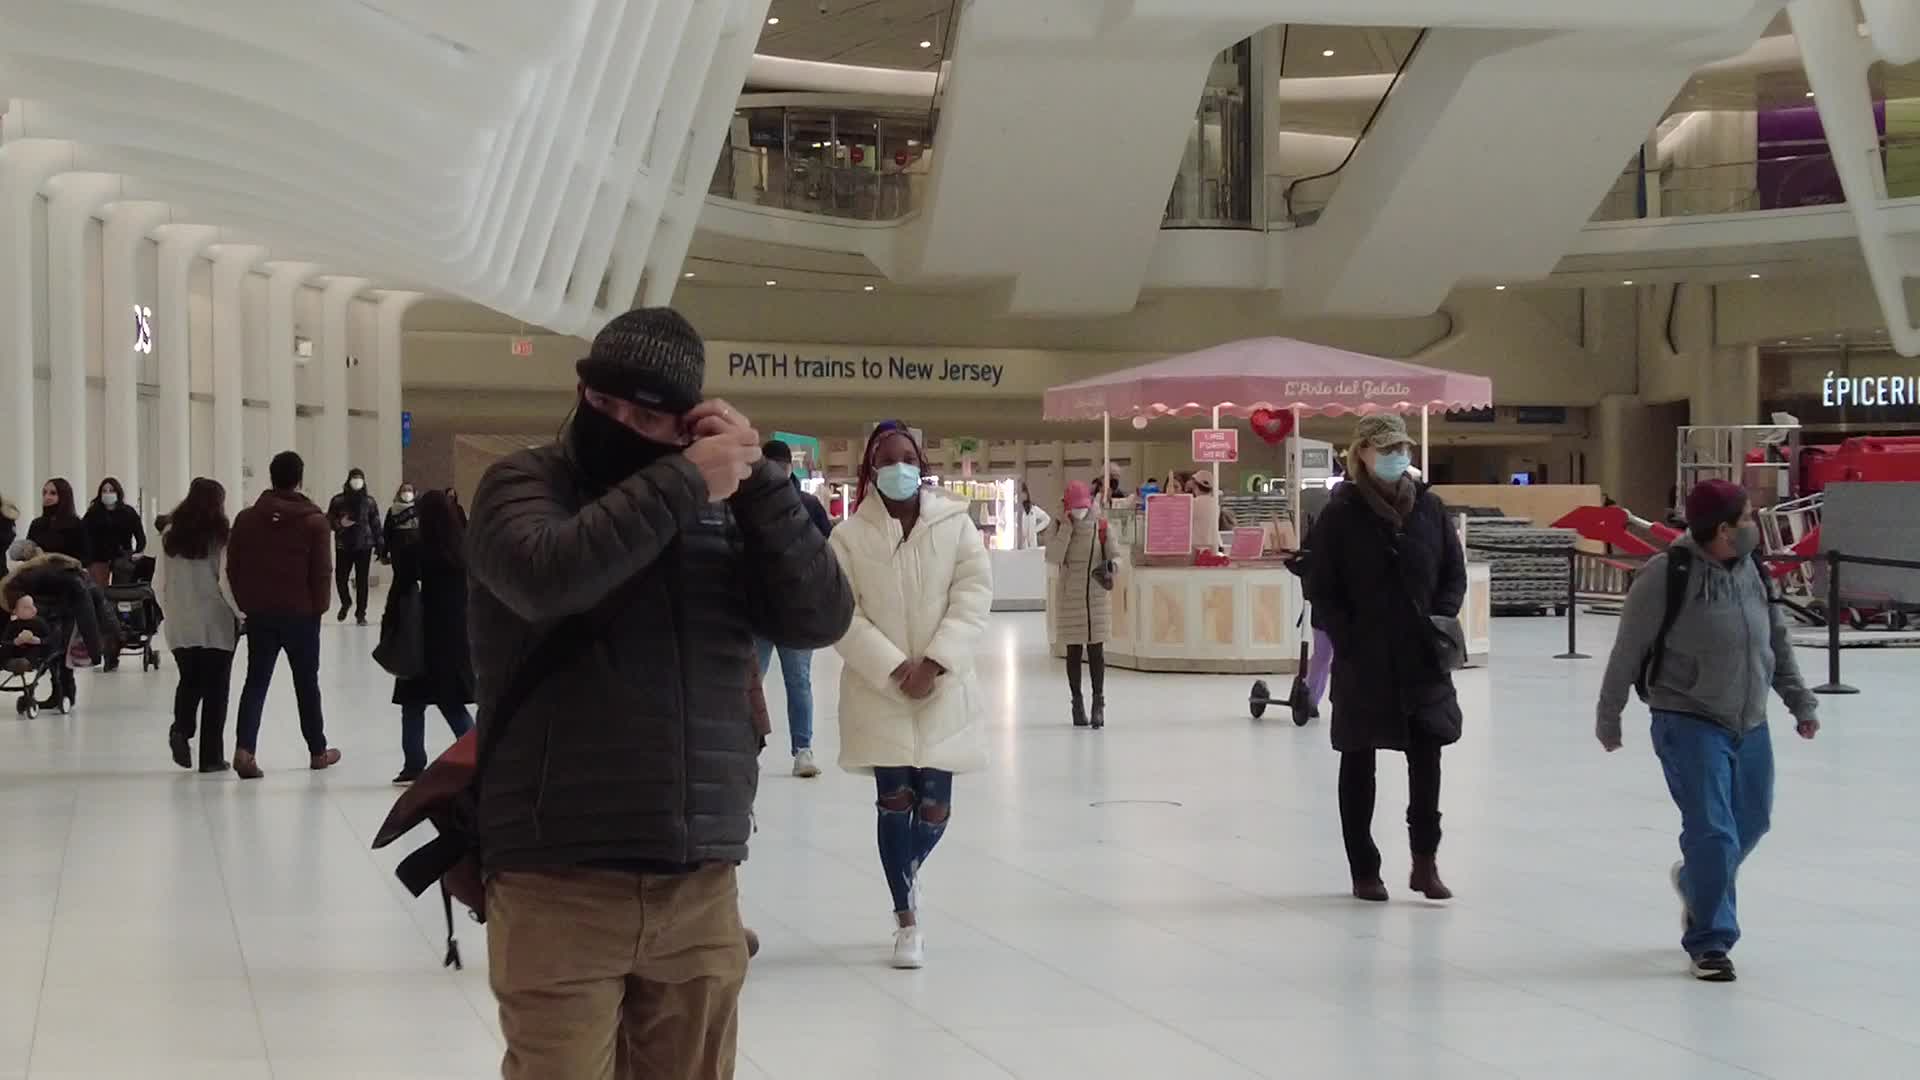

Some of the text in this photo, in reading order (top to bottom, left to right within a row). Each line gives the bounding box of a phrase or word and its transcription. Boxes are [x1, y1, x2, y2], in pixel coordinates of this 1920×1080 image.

[728, 353, 1004, 387] PATH trains to New Jersey
[1334, 381, 1359, 395] del
[1362, 380, 1410, 399] Gelato
[1823, 370, 1920, 407] ÉPICERI
